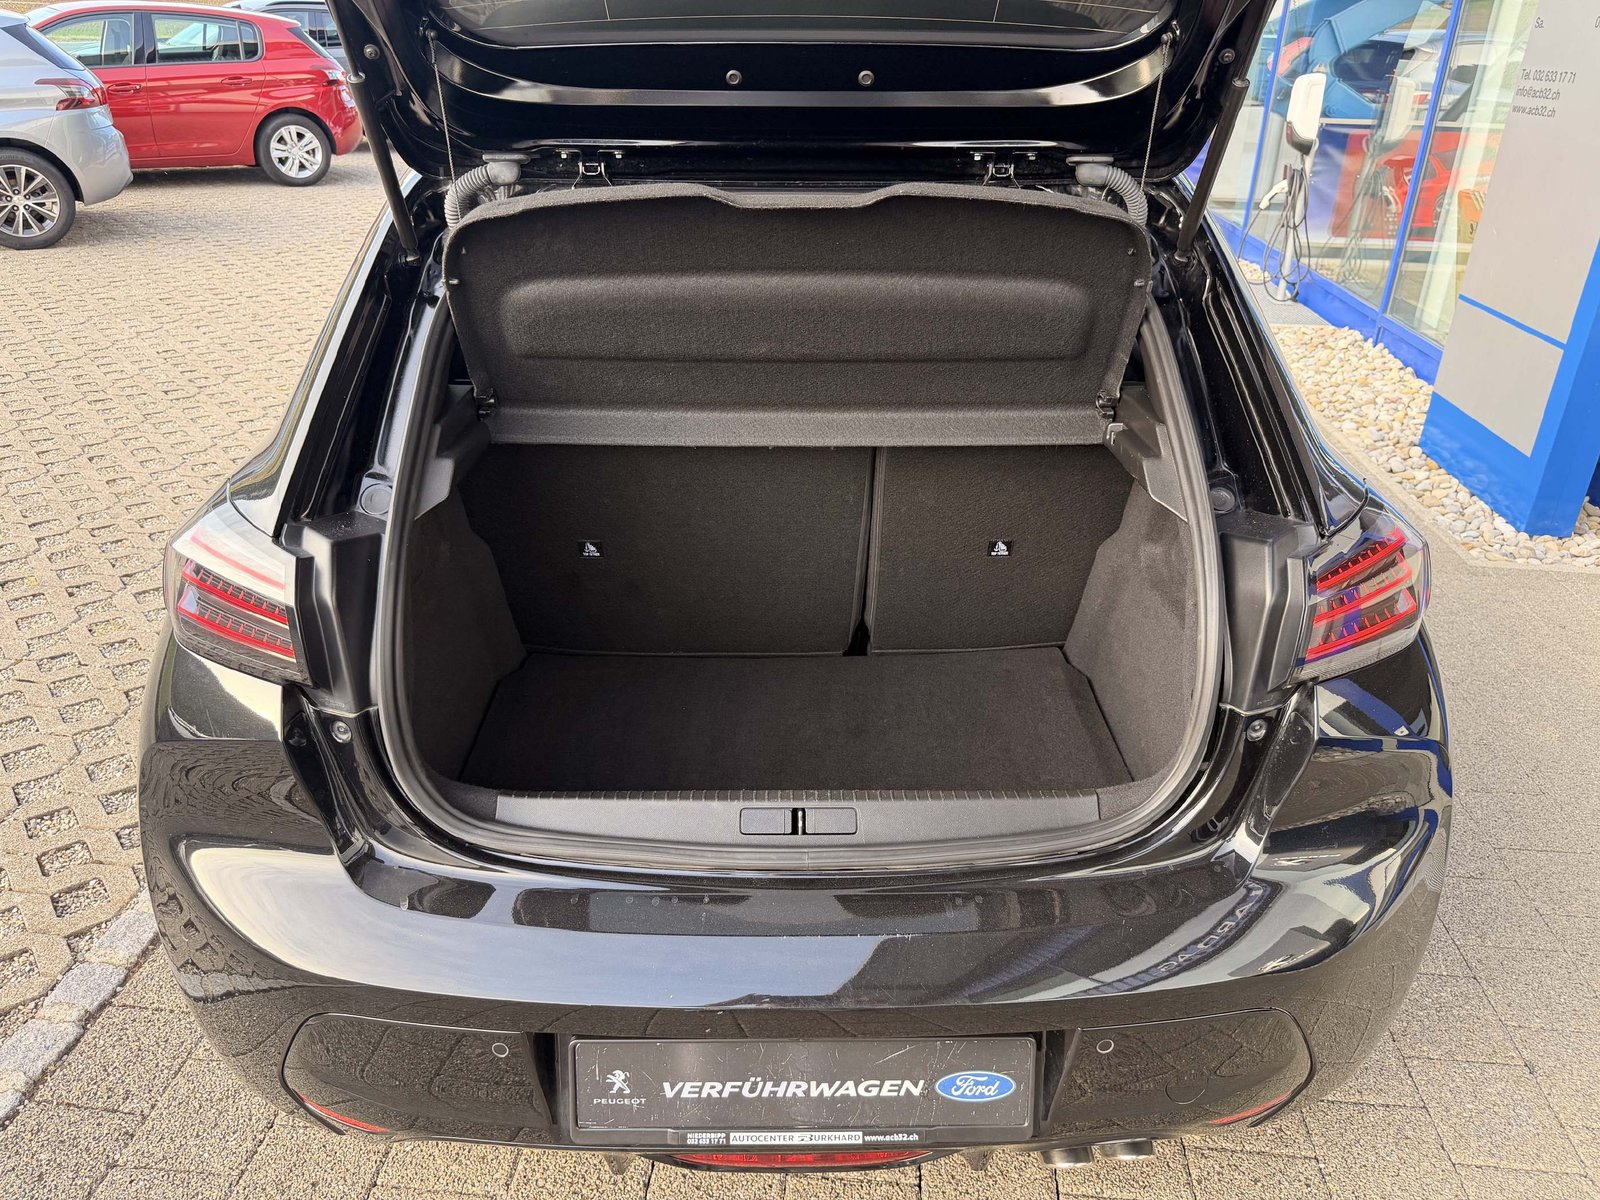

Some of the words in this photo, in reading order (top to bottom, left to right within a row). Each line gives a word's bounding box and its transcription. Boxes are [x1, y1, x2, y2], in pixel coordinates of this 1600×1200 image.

[1532, 69, 1545, 82] 032
[1545, 70, 1558, 83] 633
[1559, 71, 1568, 83] 17
[1567, 71, 1577, 84] 71
[1516, 85, 1561, 101] info@acb32.ch
[1512, 104, 1556, 118] www.acb32.ch
[662, 1077, 925, 1098] VERFÜHRWAGEN
[951, 1074, 999, 1097] Ford
[731, 1134, 794, 1142] AUTOCENTER
[864, 1133, 919, 1141] www.acb32.ch
